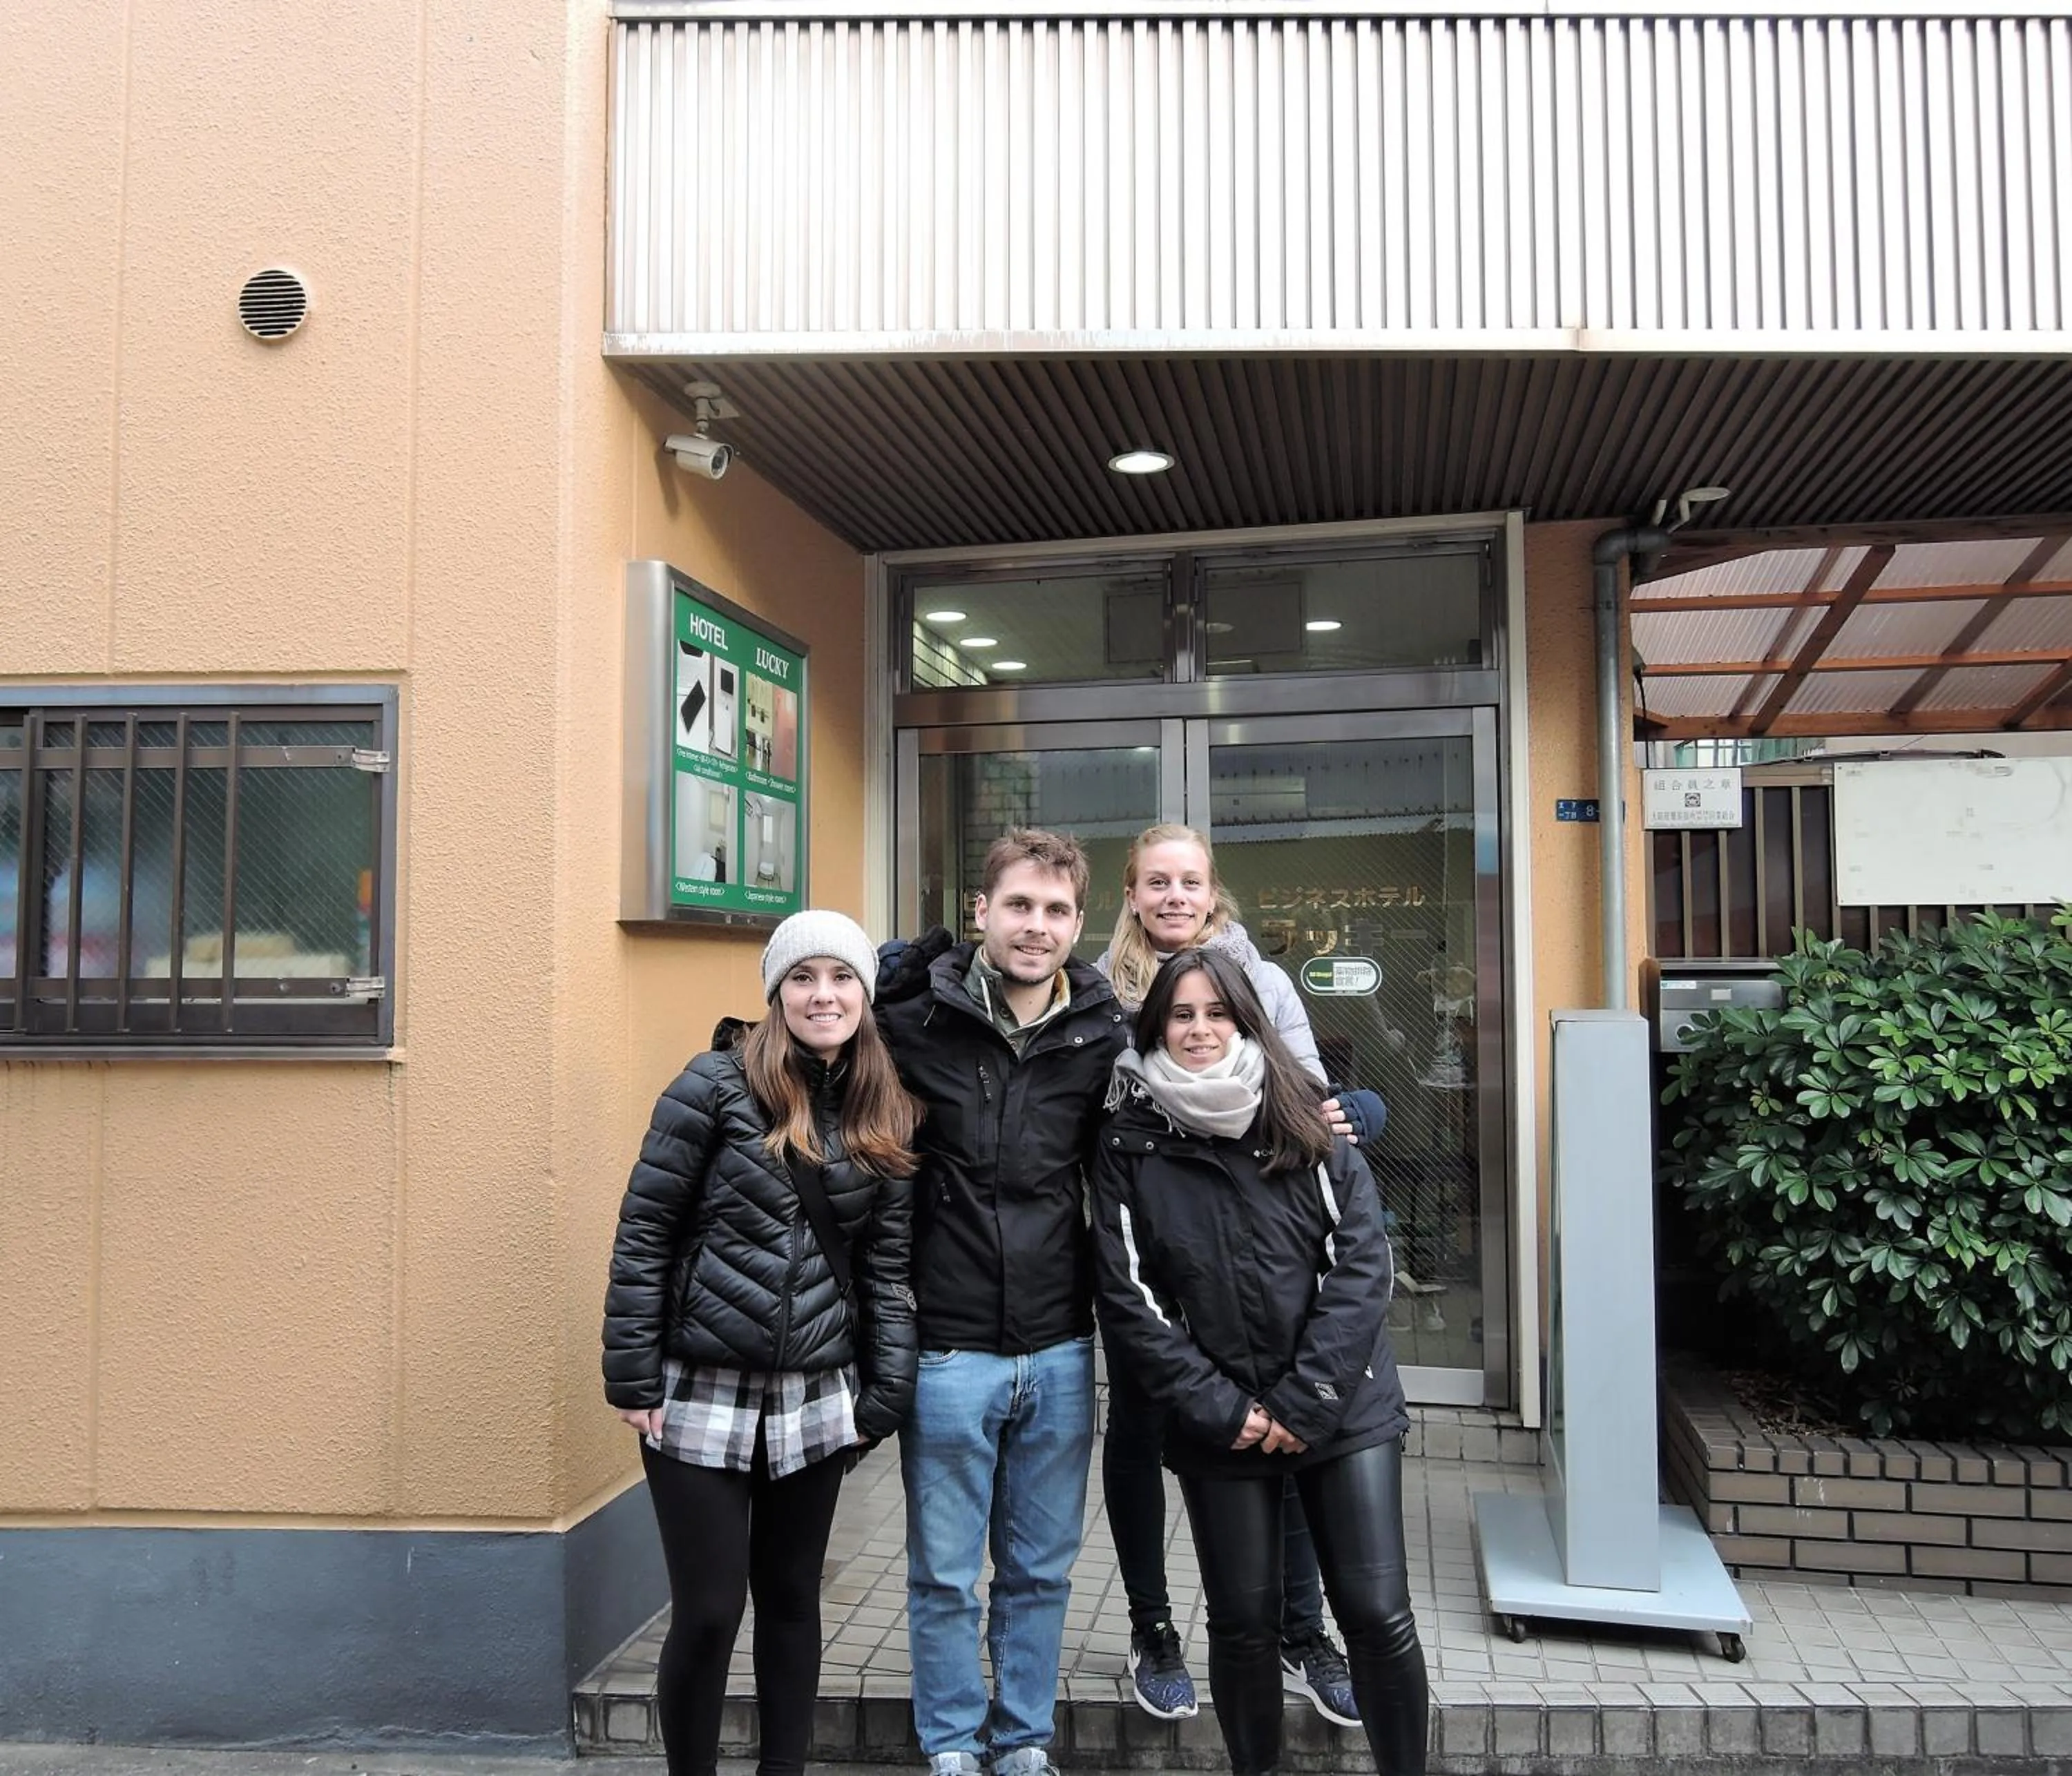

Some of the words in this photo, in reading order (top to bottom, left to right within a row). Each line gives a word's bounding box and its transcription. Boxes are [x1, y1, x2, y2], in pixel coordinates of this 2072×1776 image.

[690, 612, 729, 651] HOTEL
[756, 646, 789, 679] LUCKY
[1259, 886, 1425, 909] ビジネスホテル
[1261, 919, 1428, 956] ラッキー
